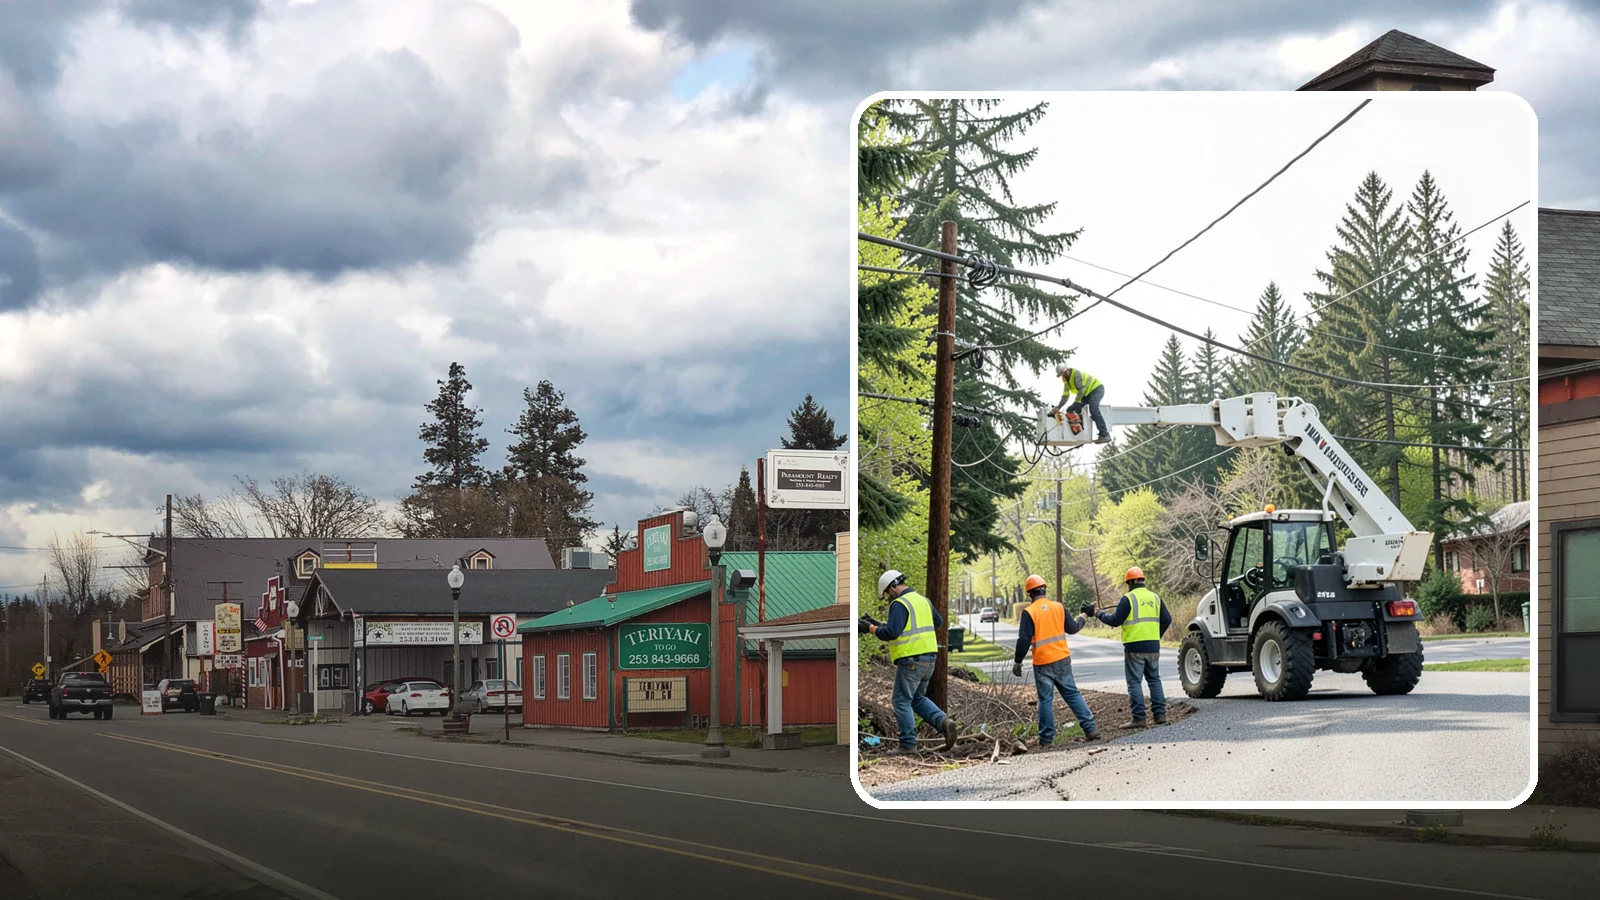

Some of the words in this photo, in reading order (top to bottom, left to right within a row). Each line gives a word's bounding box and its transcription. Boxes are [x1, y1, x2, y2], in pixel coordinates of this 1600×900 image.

[781, 471, 815, 479] PARAMOUNT
[817, 472, 839, 480] REALTY
[624, 627, 703, 646] TERIYAKI
[628, 654, 648, 665] 253
[651, 653, 700, 664] 843-9668
[639, 681, 673, 691] TERIYAKI
